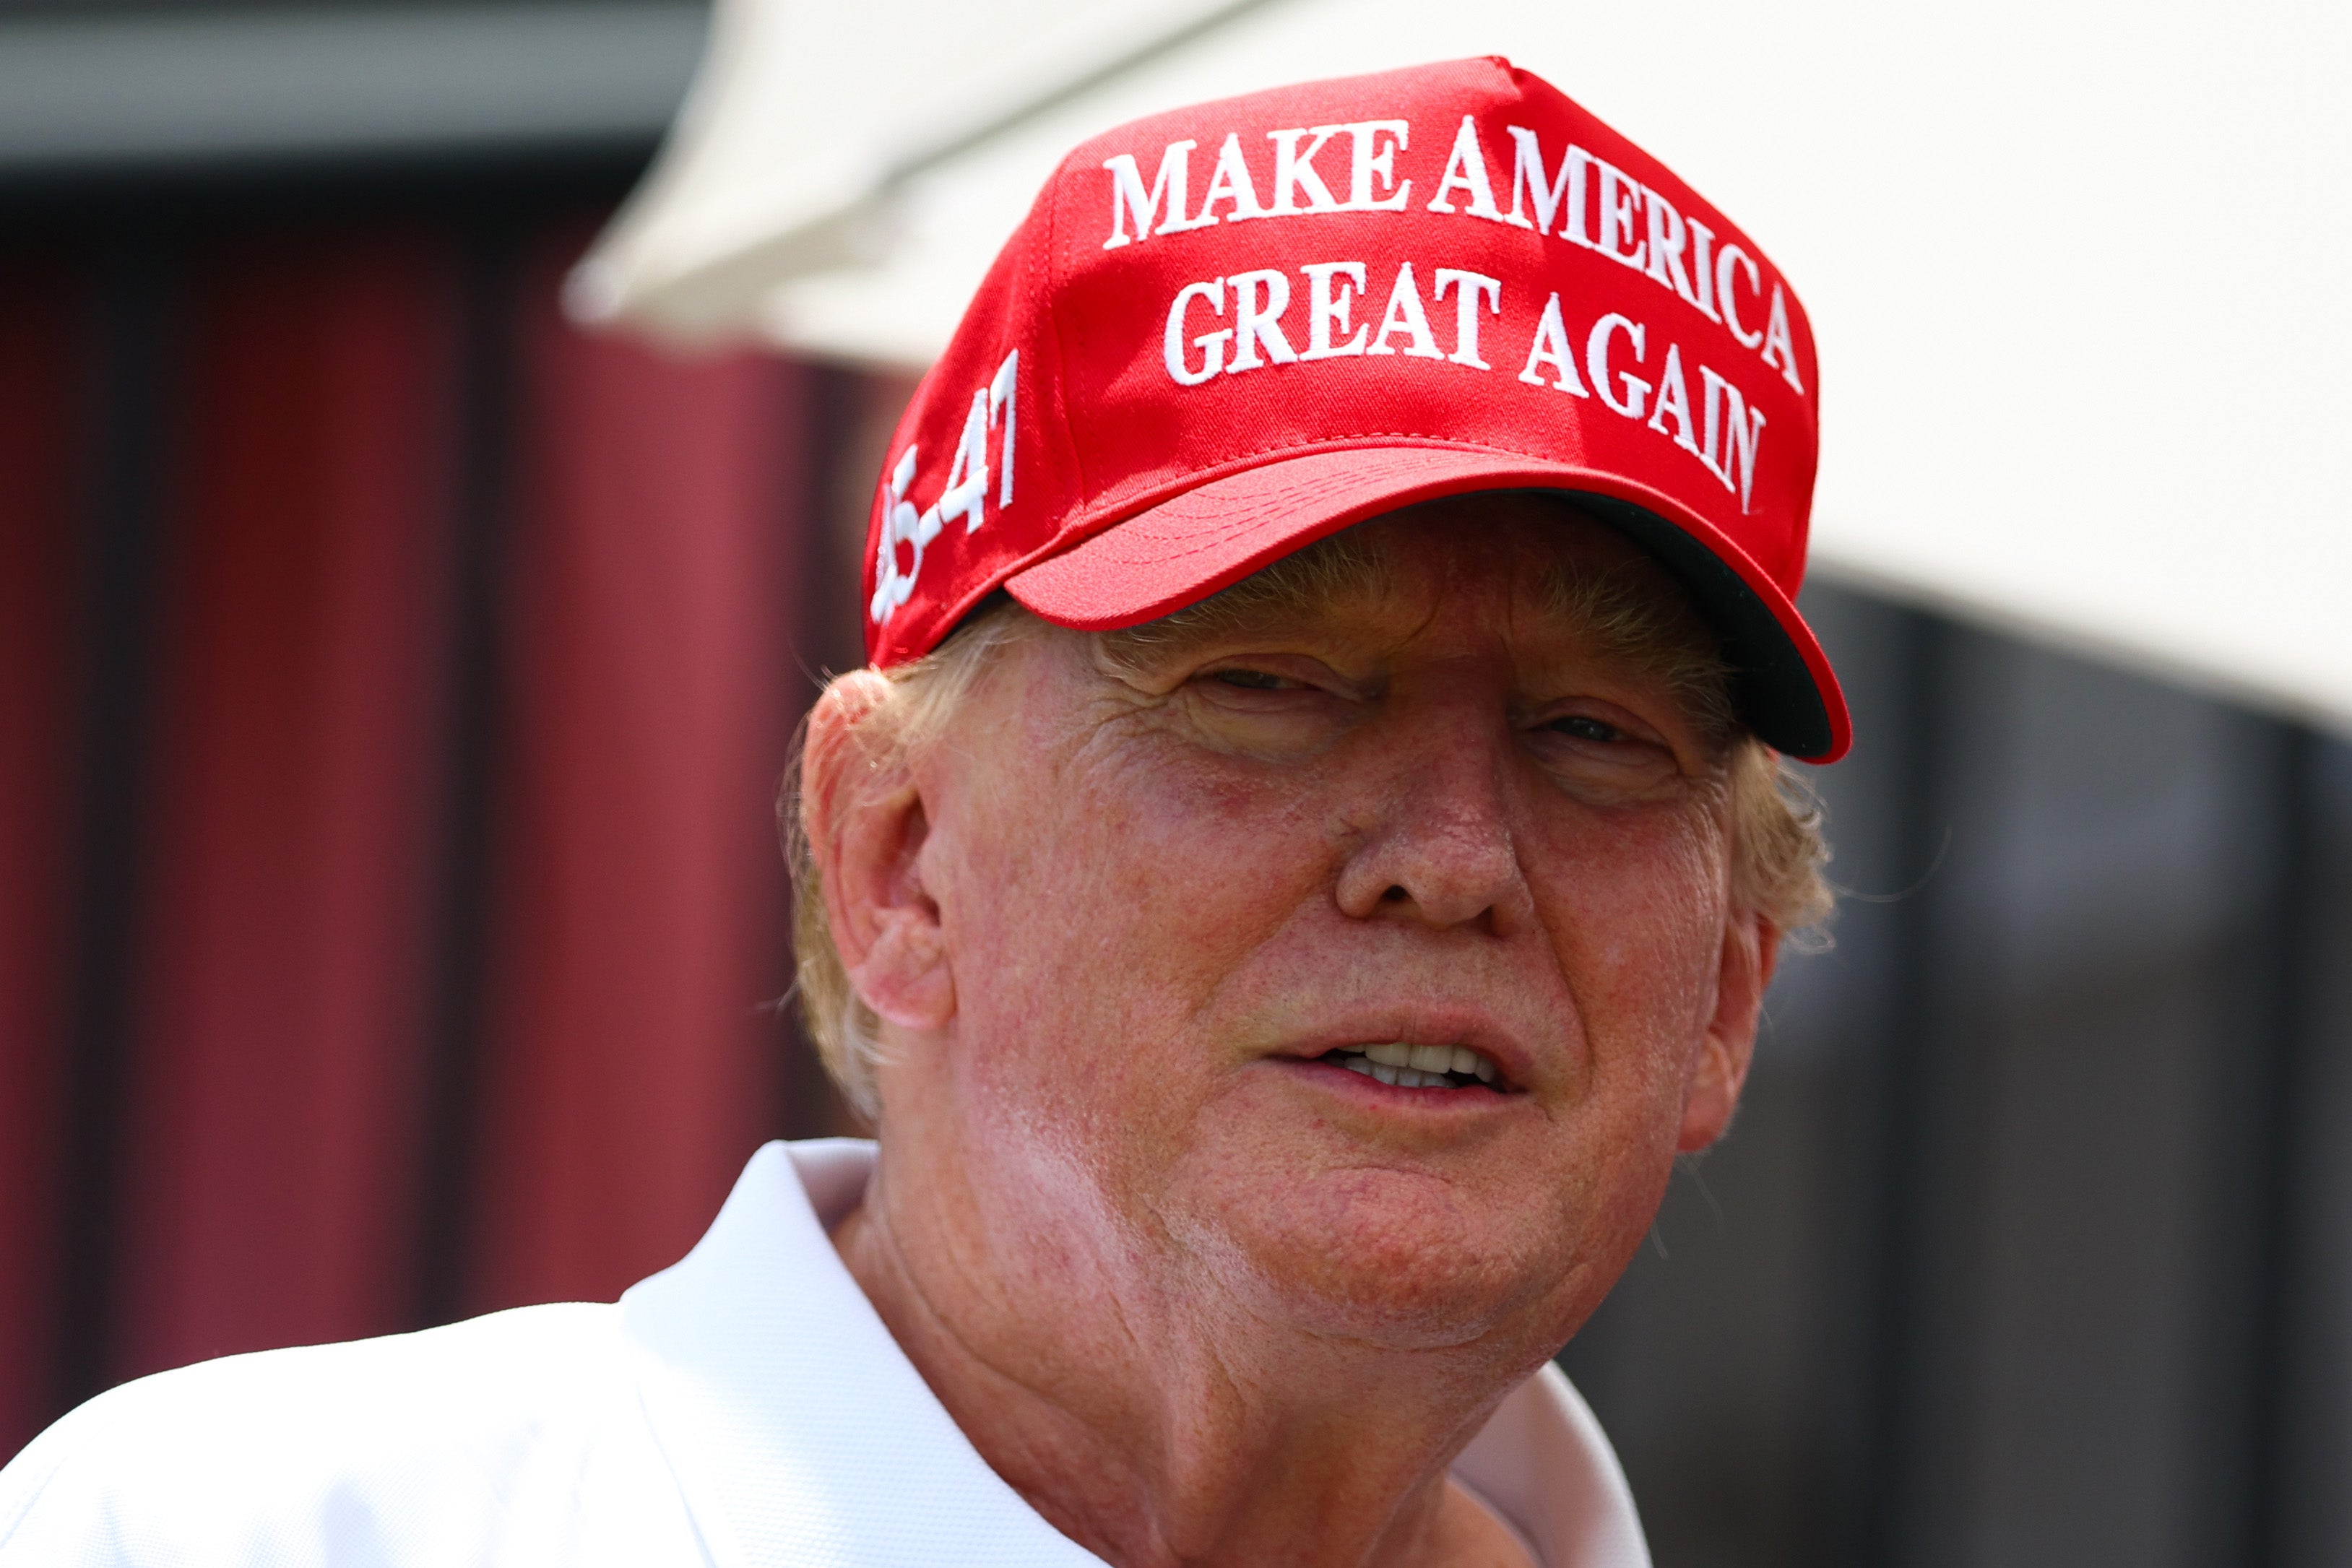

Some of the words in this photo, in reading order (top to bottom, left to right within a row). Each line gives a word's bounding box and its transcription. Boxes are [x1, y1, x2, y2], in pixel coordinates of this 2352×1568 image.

[1102, 117, 1411, 251] MAKE
[1427, 114, 1805, 396] AMERICA
[1162, 261, 1501, 386] GREAT
[1518, 292, 1766, 515] AGAIN
